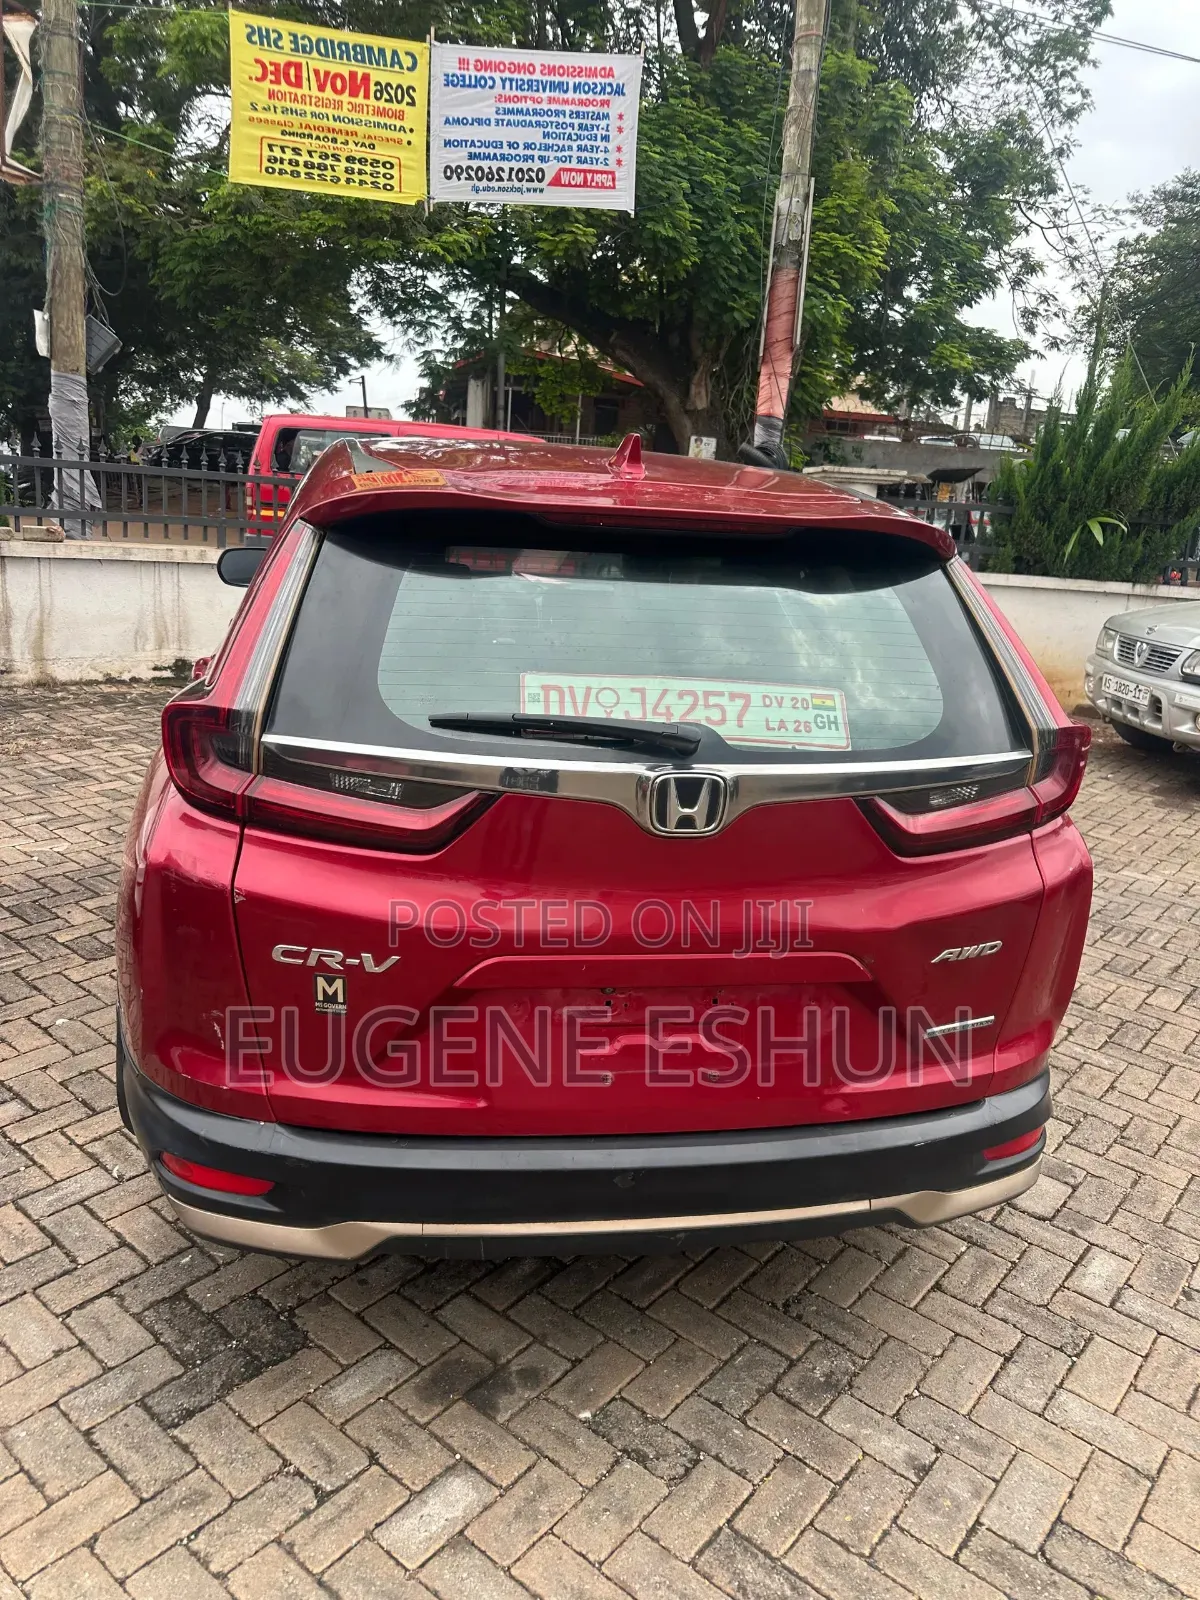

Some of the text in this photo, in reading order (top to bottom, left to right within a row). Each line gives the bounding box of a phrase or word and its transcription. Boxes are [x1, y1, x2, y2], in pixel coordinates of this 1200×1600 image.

[540, 684, 592, 718] DV
[762, 694, 810, 710] DV 20
[764, 718, 812, 734] LA 26
[814, 713, 840, 732] GH
[272, 944, 402, 973] CR-V
[930, 940, 1003, 964] AWD
[316, 976, 344, 1003] M
